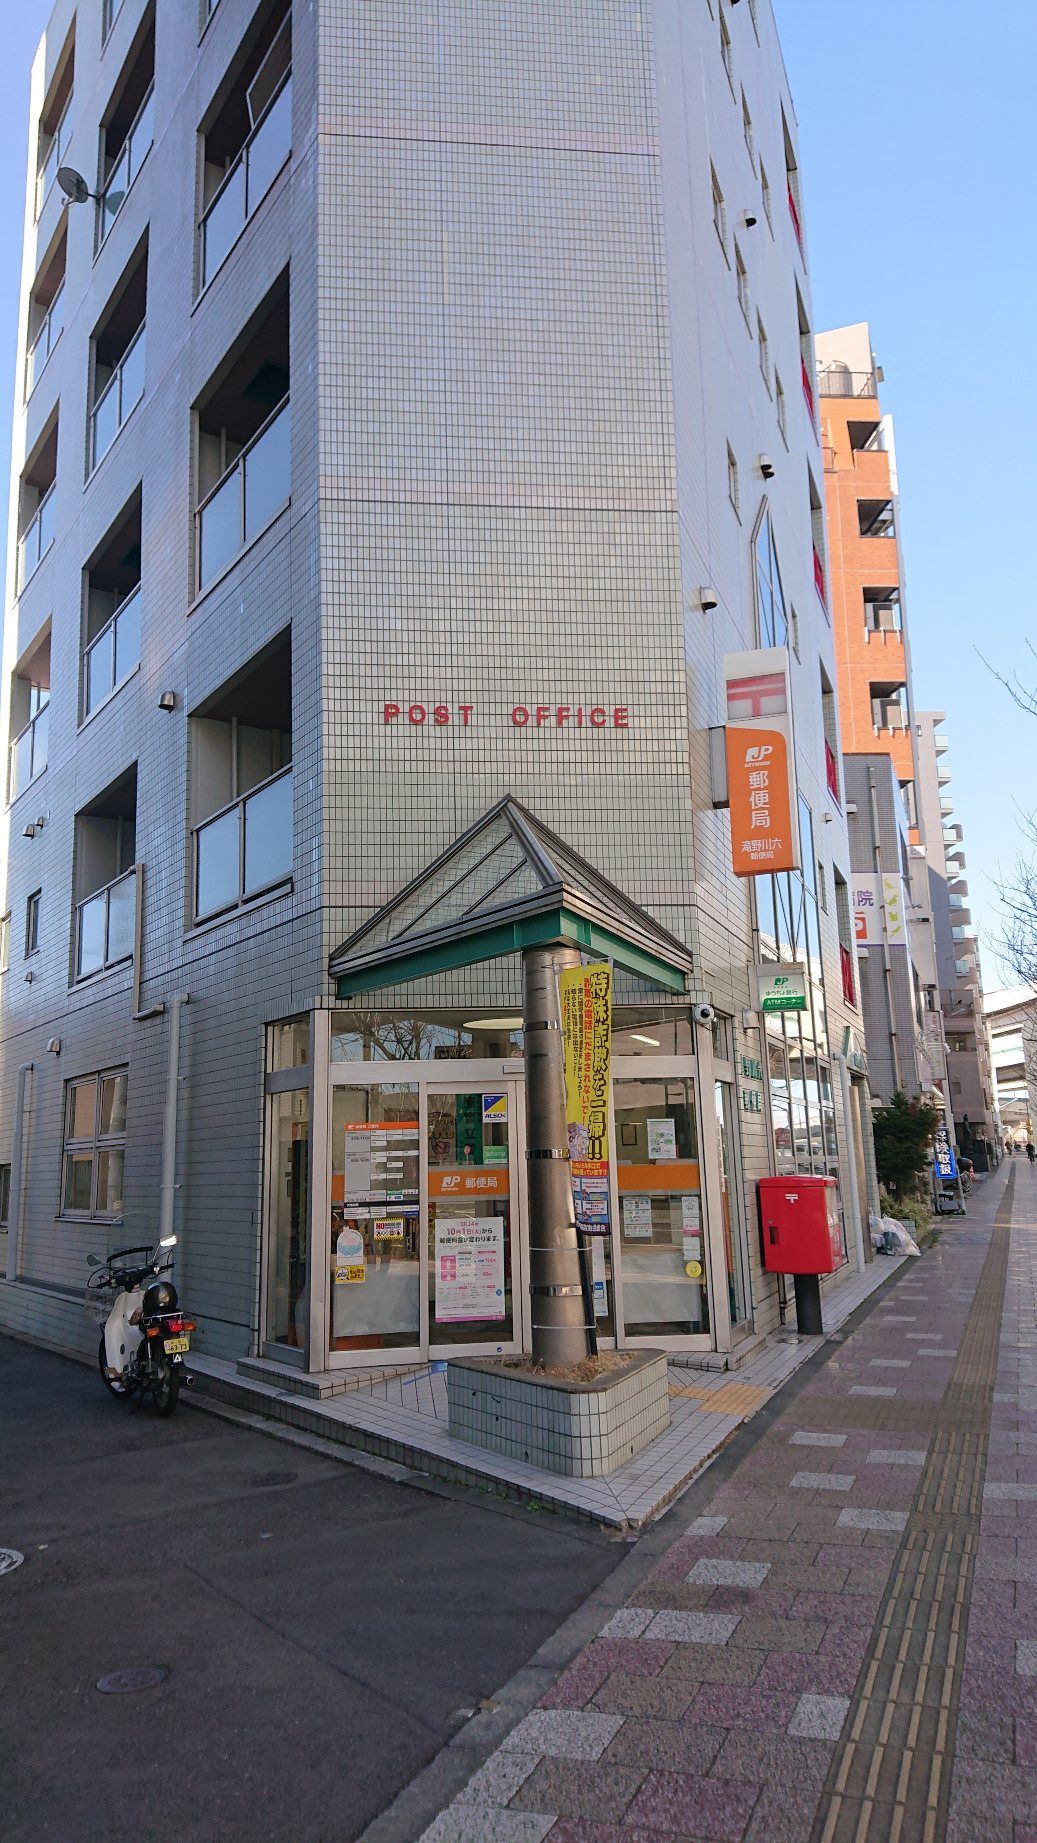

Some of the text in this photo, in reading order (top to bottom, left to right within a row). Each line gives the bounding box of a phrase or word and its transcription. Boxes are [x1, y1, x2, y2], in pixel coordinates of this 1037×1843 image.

[384, 704, 630, 728] POST OFFICE
[745, 745, 774, 763] JP
[744, 760, 772, 768] NETWORK
[748, 770, 772, 829] 郵便局
[741, 838, 782, 853] 滝野川六
[852, 889, 874, 906] 院
[774, 977, 789, 986] JP
[765, 989, 798, 997] ゆうちょ銀行
[441, 1176, 460, 1188] JP
[465, 1176, 497, 1188] 郵便局
[376, 1222, 385, 1230] NO
